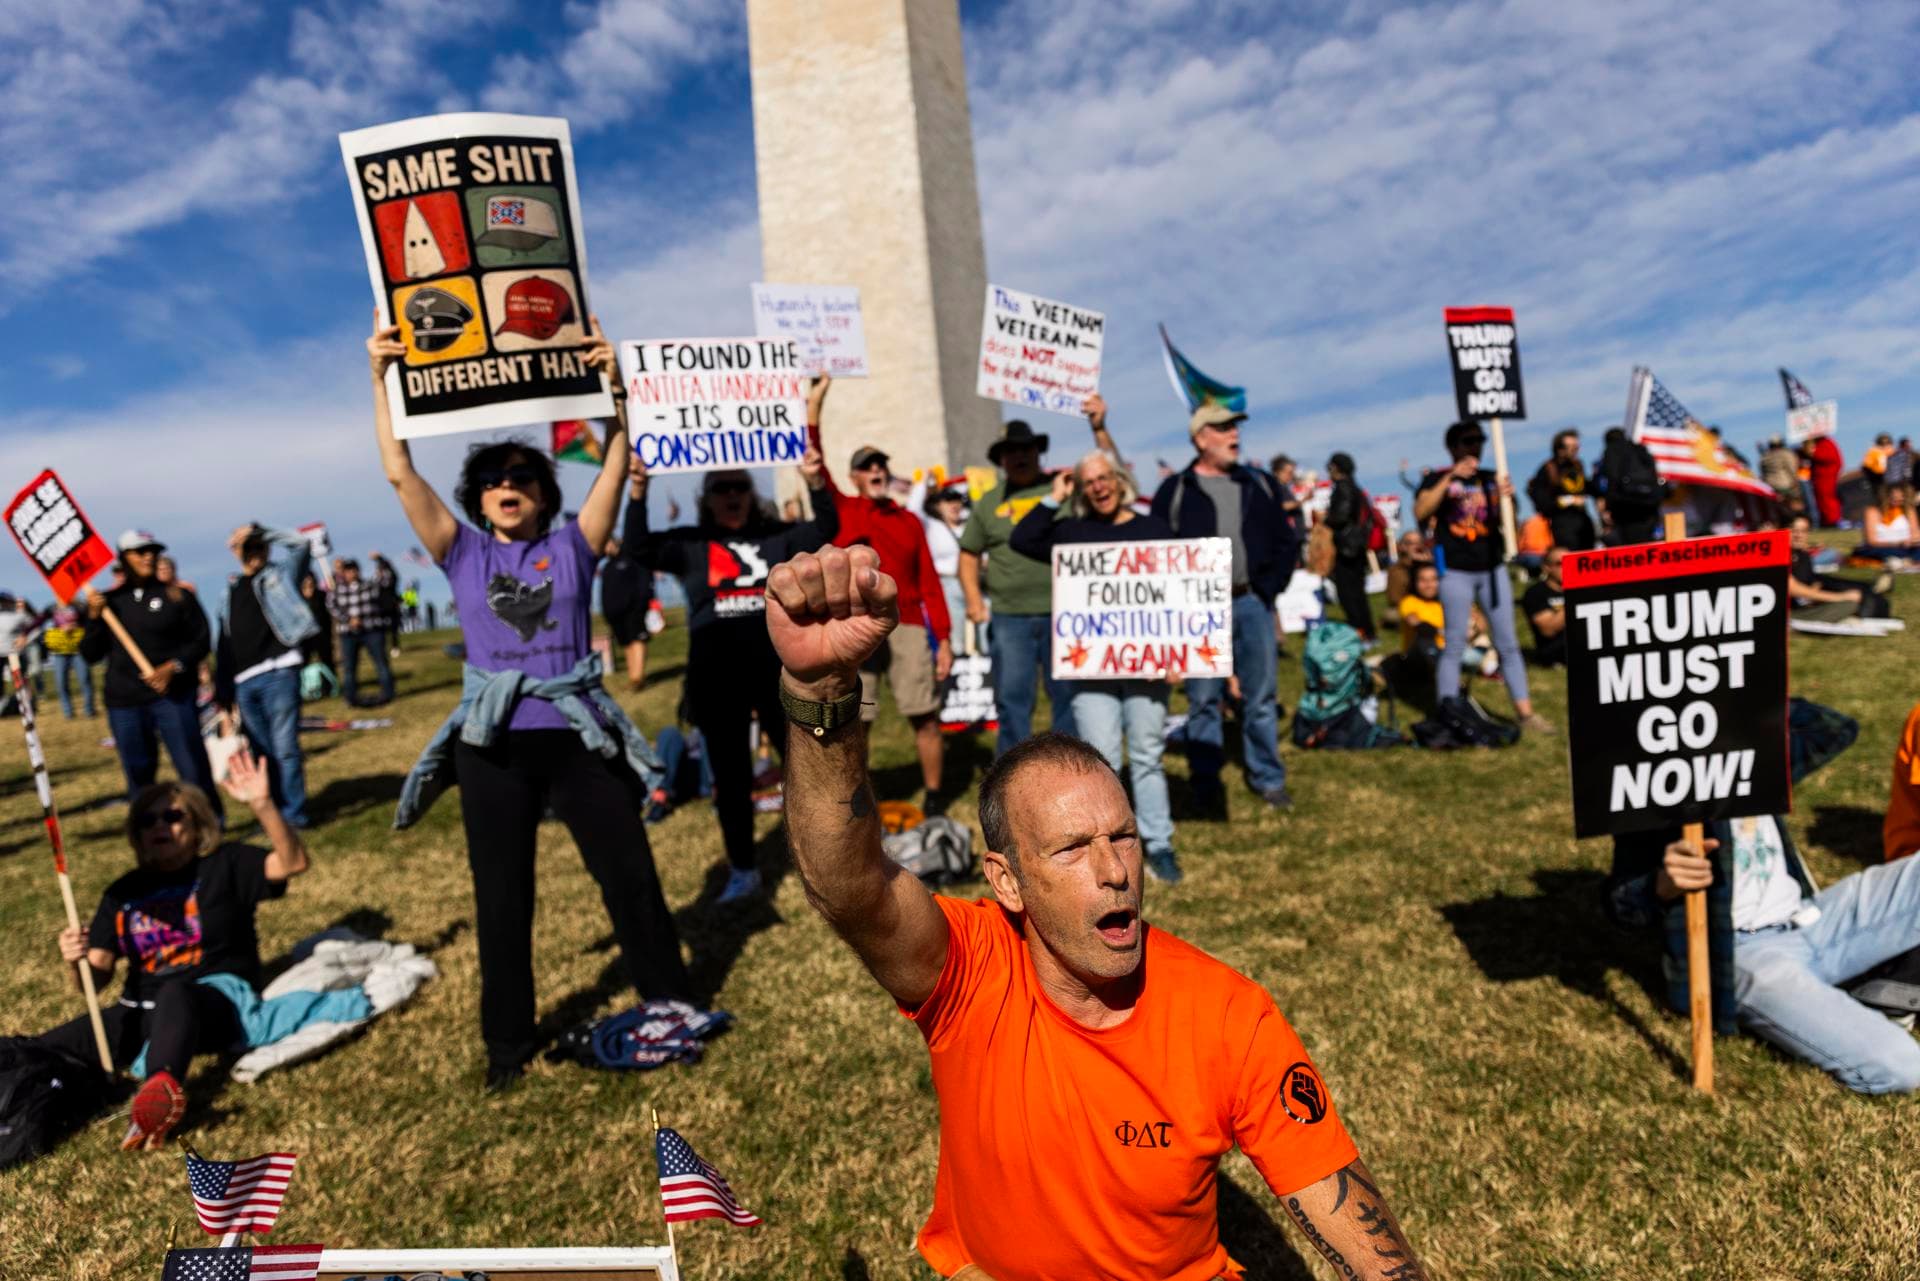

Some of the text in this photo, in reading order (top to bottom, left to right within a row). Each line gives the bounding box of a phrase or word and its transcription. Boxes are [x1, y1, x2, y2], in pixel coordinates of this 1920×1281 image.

[364, 144, 553, 201] SAME SHIT
[1031, 299, 1104, 334] VIETNAM
[1449, 324, 1515, 348] TRUMP
[634, 344, 648, 372] I
[660, 342, 752, 371] FOUND
[756, 340, 799, 368] THE
[1021, 344, 1057, 367] NOT
[1457, 346, 1512, 371] MUST
[406, 350, 588, 398] DIFFERENT HAT
[628, 373, 802, 404] ANTIFA HANDBOOK
[677, 403, 722, 429] IT'S
[738, 403, 792, 428] OUR
[635, 424, 807, 469] CONSTITUTION
[1057, 548, 1114, 577] MAKE
[1577, 537, 1772, 573] RefuseFascism.org
[1181, 576, 1226, 603] THE
[1057, 608, 1226, 639] CONSTITUTION
[1575, 583, 1776, 650] TRUMP
[1102, 642, 1188, 674] AGAIN
[1598, 640, 1755, 704] MUST
[1637, 700, 1719, 754] GO
[1610, 749, 1756, 812] NOW!
